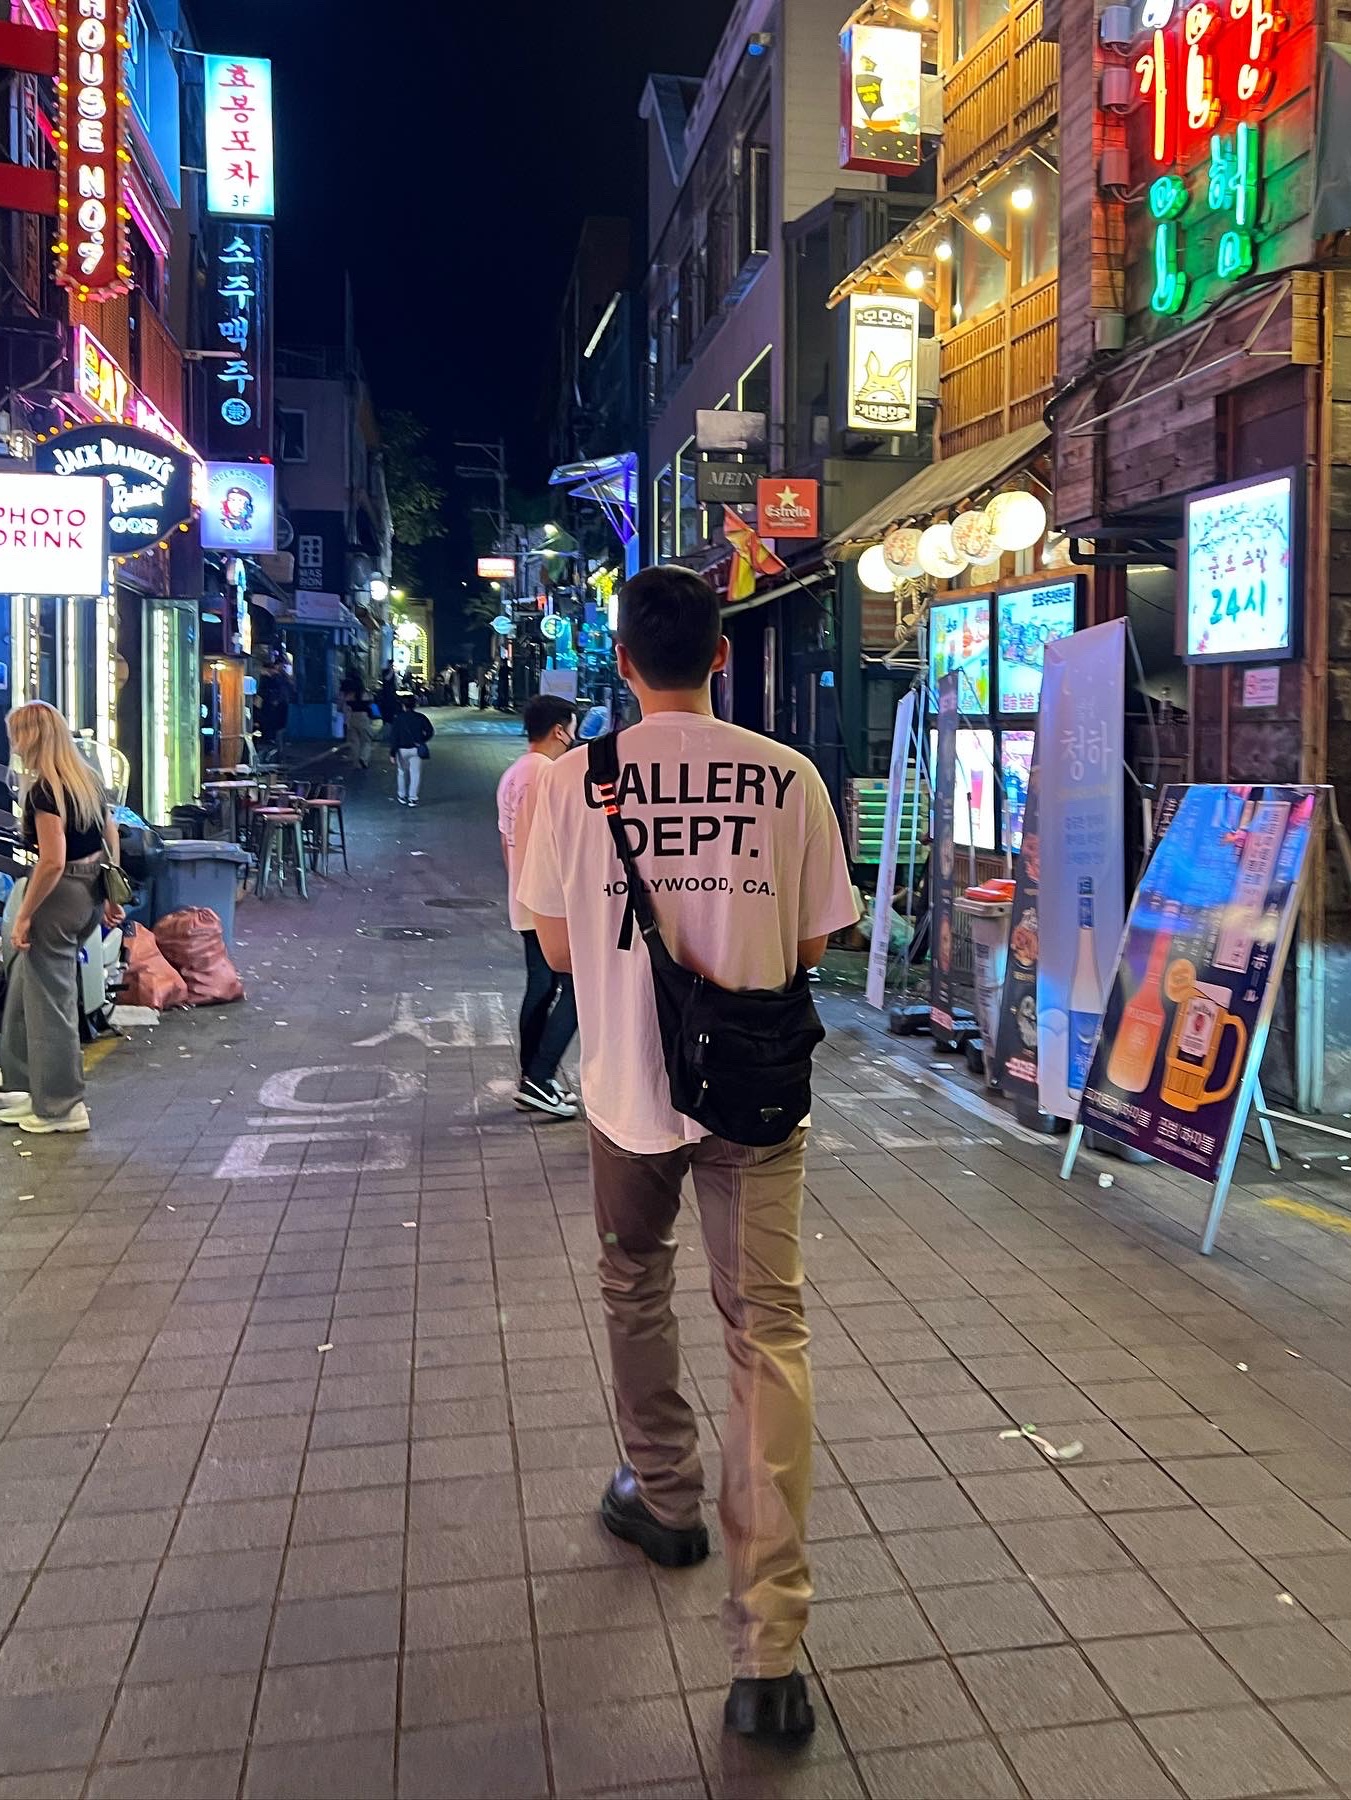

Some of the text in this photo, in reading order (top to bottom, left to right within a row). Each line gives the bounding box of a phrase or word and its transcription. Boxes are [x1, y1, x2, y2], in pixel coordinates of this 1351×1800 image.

[78, 165, 106, 275] NO.7
[231, 195, 250, 207] 3F
[52, 438, 175, 486] JACK DANIEL'S
[764, 504, 811, 518] Estrella
[1209, 580, 1266, 625] 24시
[1060, 720, 1114, 781] 청하
[617, 816, 760, 859] DEPT.
[603, 877, 776, 897] HOLYWOOD, CA.
